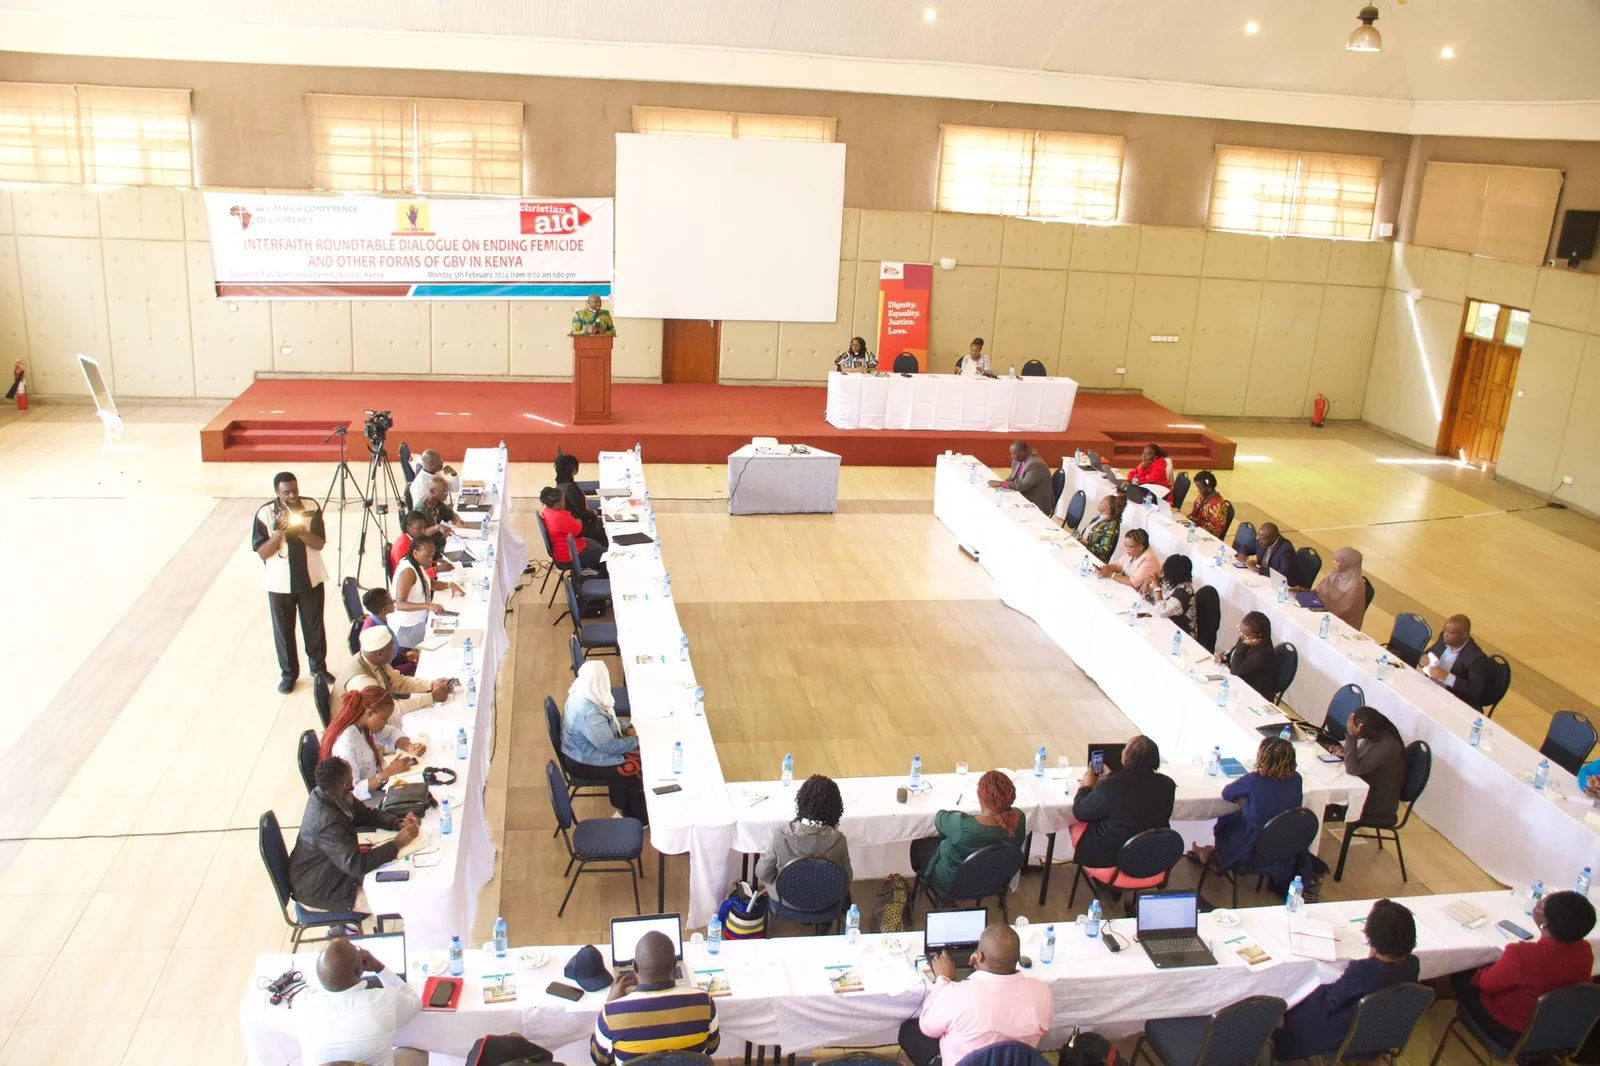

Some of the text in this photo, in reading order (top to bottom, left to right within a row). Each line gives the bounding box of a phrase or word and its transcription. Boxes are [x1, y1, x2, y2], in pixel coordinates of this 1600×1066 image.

[255, 205, 358, 213] ALL AFRICA CONFERENCE
[519, 203, 567, 214] christian
[256, 216, 314, 224] OF CHURCHES
[534, 207, 580, 234] aid
[243, 238, 585, 252] INTERFAITH ROUNDTABLE DIALOGUE ON ENDING FEMICIDE
[308, 255, 523, 268] AND OTHER FORMS OF GBV IN KENYA
[427, 271, 453, 279] Monday
[453, 271, 464, 279] 5th
[465, 271, 493, 279] February
[510, 271, 526, 279] from
[565, 272, 577, 280] pm
[888, 301, 917, 310] Dignity.
[888, 310, 920, 318] Equality.
[888, 327, 908, 335] Love.
